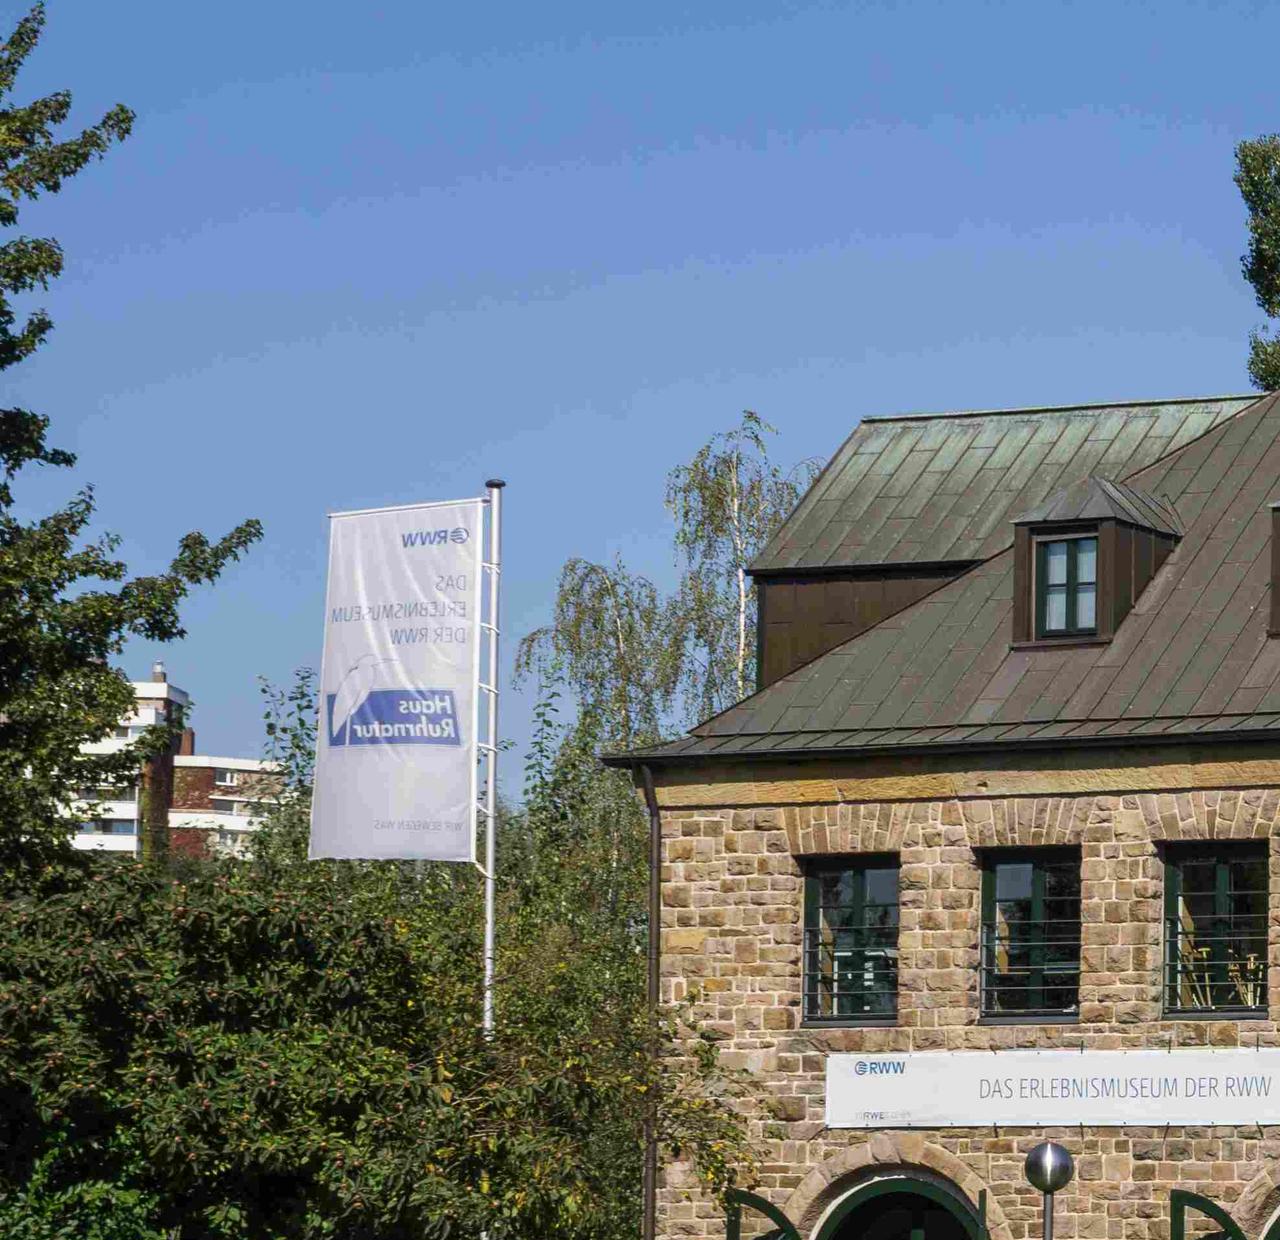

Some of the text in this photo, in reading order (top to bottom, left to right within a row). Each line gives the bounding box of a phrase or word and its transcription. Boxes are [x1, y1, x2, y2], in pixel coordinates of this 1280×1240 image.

[869, 1061, 905, 1075] RWW
[980, 1076, 1272, 1098] DAS ERLEBNISMUSEUM DER RWW
